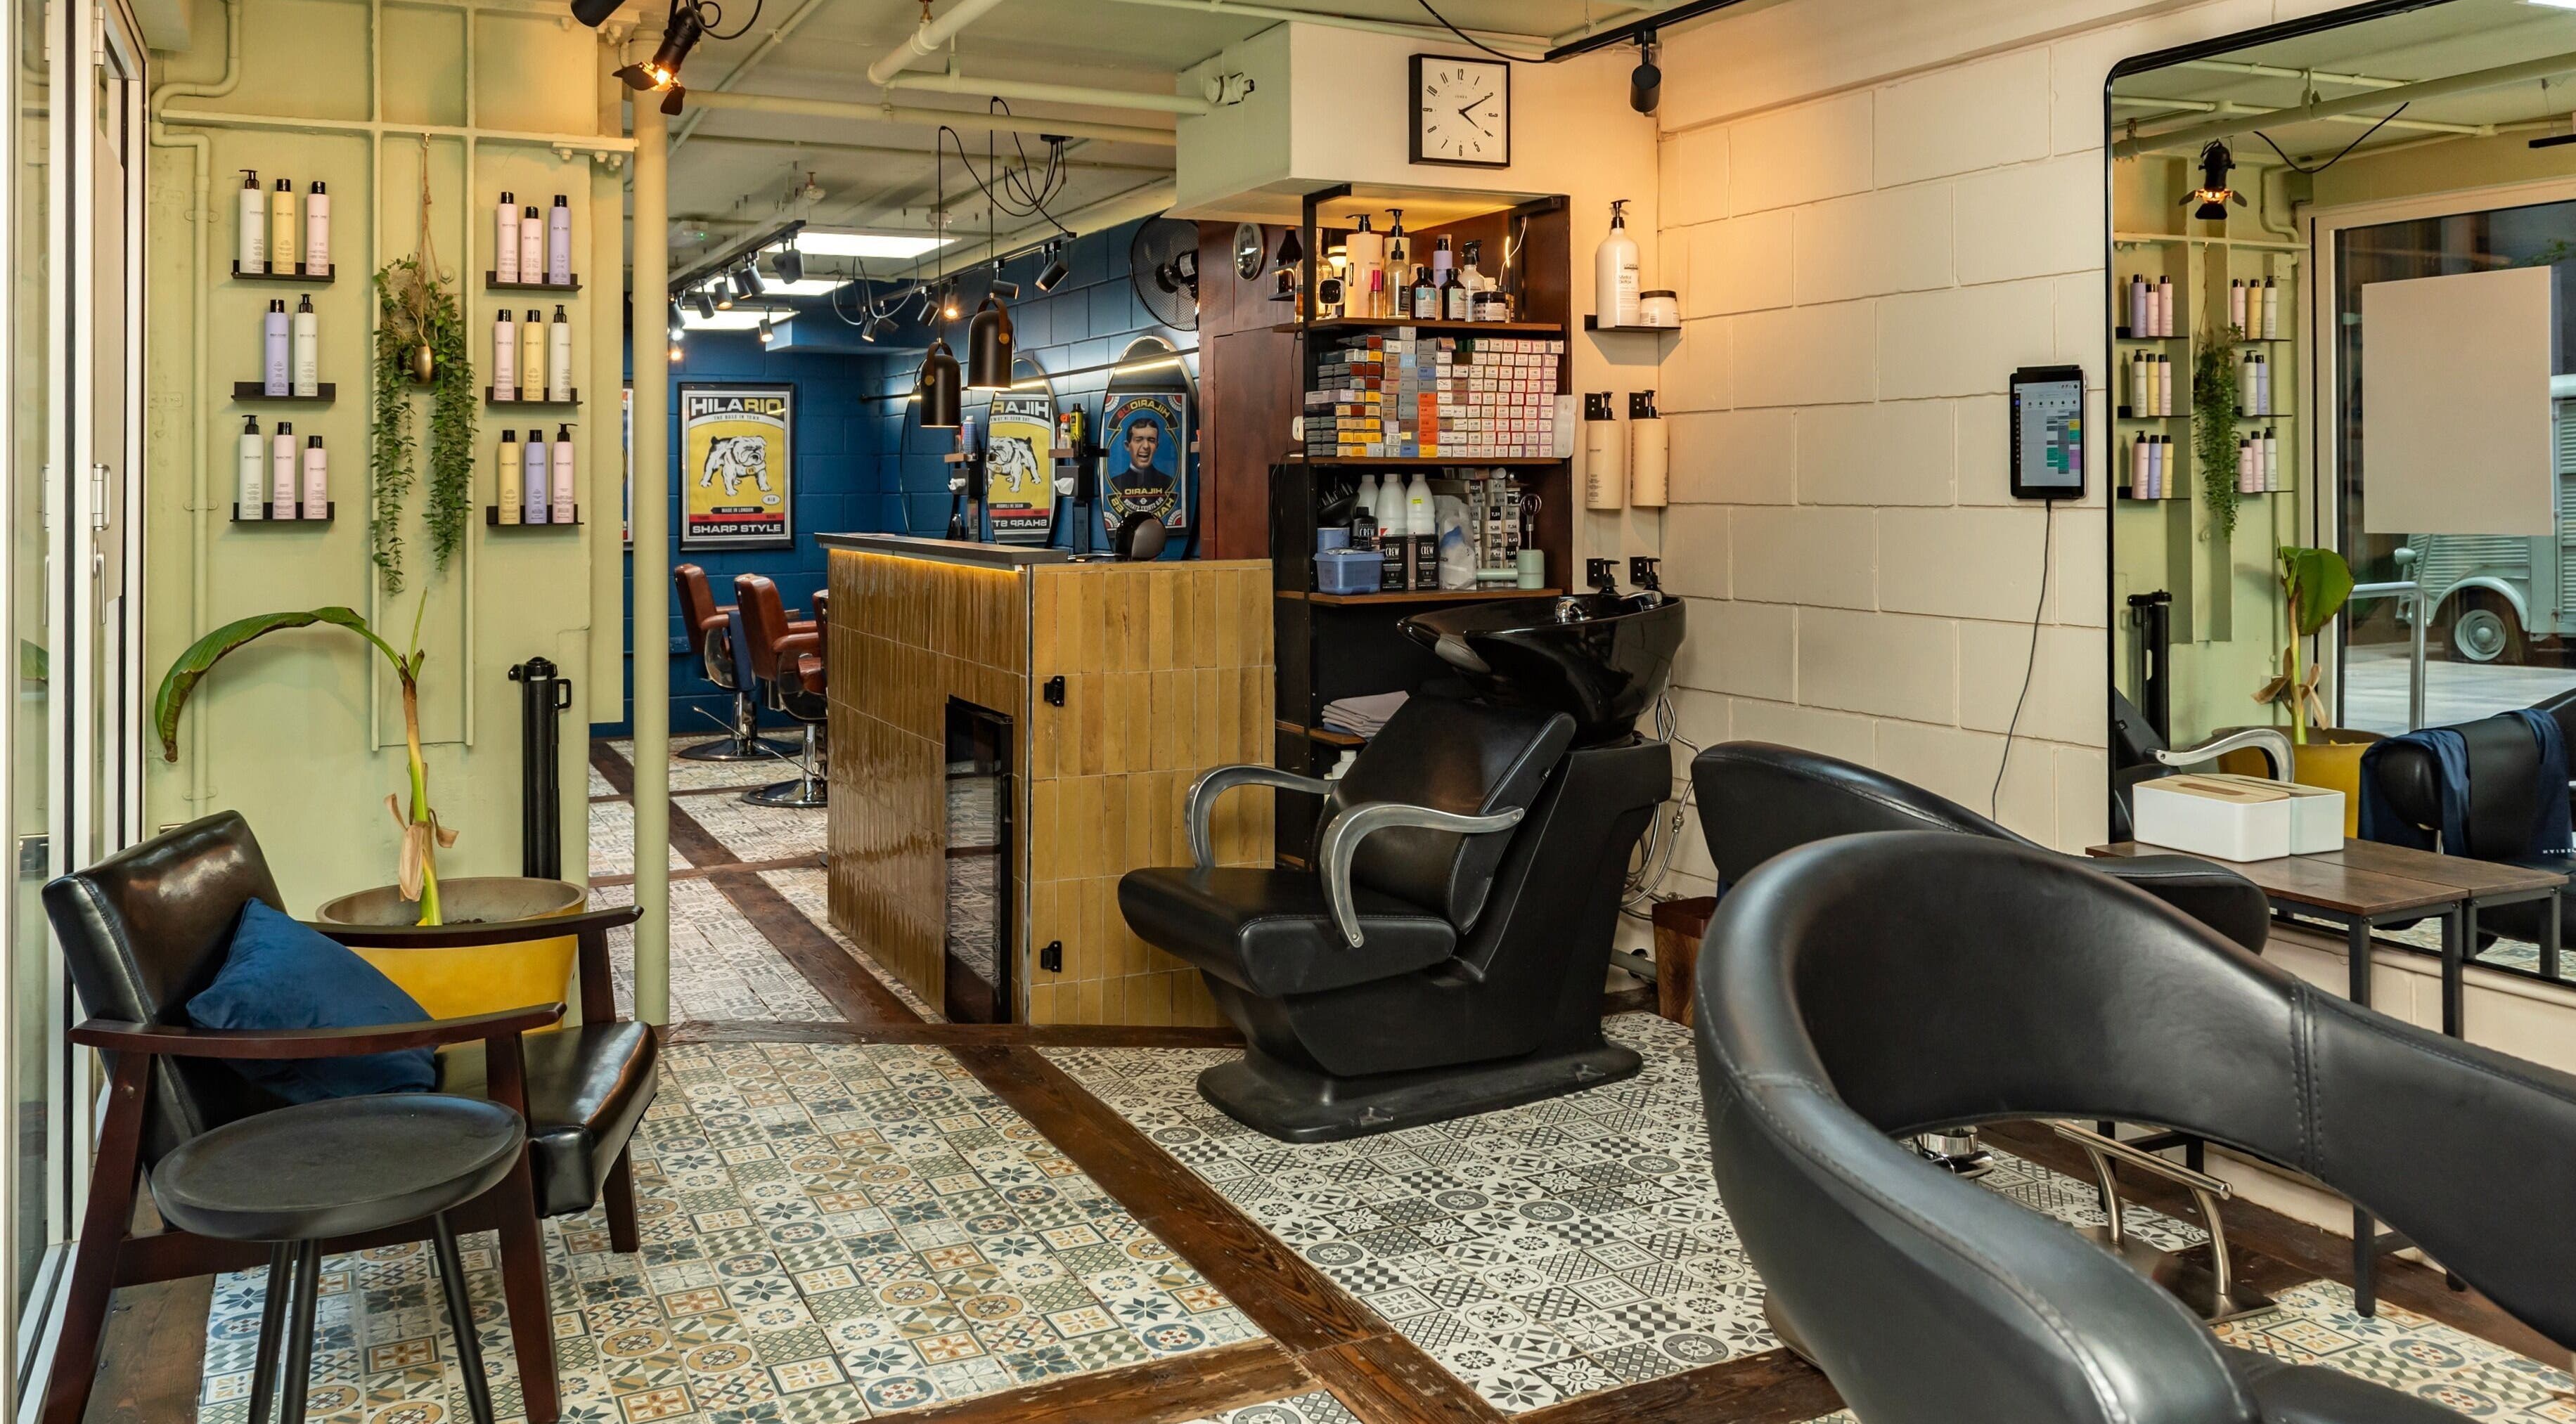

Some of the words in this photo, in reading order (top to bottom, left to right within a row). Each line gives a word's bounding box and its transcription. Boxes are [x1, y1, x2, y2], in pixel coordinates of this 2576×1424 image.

[1440, 72, 1448, 84] 11
[1457, 68, 1464, 80] 12
[1474, 76, 1480, 86] 1
[1426, 85, 1438, 97] 10
[1441, 139, 1448, 149] 7
[1474, 141, 1481, 153] 5
[1459, 145, 1463, 157] 6
[690, 398, 782, 416] HILARIO
[693, 525, 738, 533] SHARP
[740, 524, 781, 533] STYLE
[1359, 528, 1375, 537] CREW
[1385, 548, 1400, 557] CREW
[1421, 546, 1434, 555] CREW
